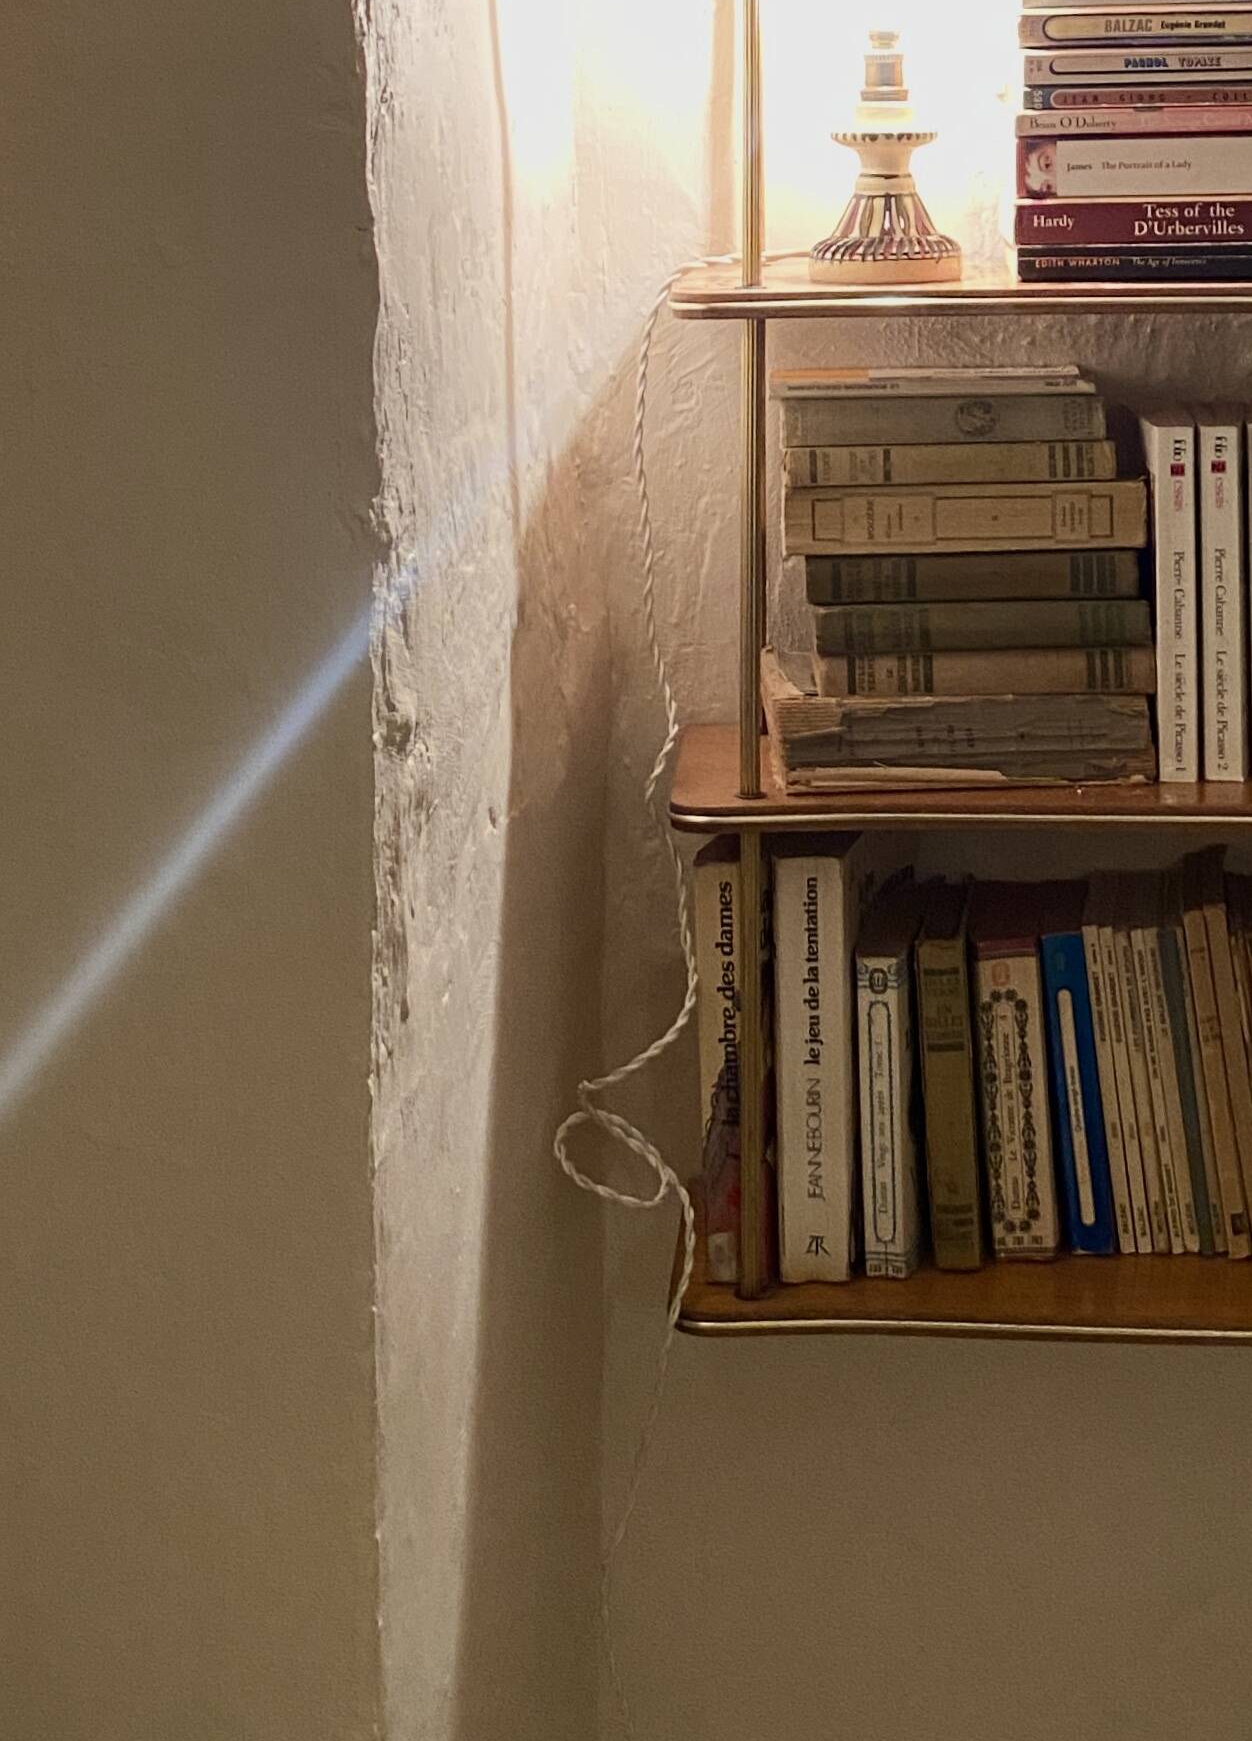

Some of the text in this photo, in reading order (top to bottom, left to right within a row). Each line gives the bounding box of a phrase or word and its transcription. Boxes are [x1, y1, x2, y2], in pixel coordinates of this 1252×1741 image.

[1104, 19, 1153, 33] BALZAC
[1067, 163, 1093, 172] James
[1101, 161, 1117, 170] The
[1118, 161, 1154, 170] Portrait
[1155, 161, 1164, 169] of
[1172, 160, 1192, 170] Lady
[1143, 202, 1235, 218] Tess of the
[1033, 214, 1075, 229] Hardy
[1134, 219, 1245, 236] D'Urbervilles
[1035, 259, 1065, 269] EDITH
[1068, 257, 1120, 267] WHARTON
[1215, 549, 1226, 583] Pierre
[1175, 654, 1186, 669] Le
[1216, 651, 1227, 665] Le
[1176, 705, 1186, 719] de
[1217, 702, 1227, 716] de
[1176, 724, 1186, 762] Picasso
[1218, 720, 1228, 759] Picasso
[715, 881, 734, 956] dames
[716, 961, 735, 1001] des
[803, 876, 825, 1201] JEANNE BOURIN le jeu de la tentation
[718, 1007, 740, 1102] chambre
[1007, 1149, 1017, 1161] Le
